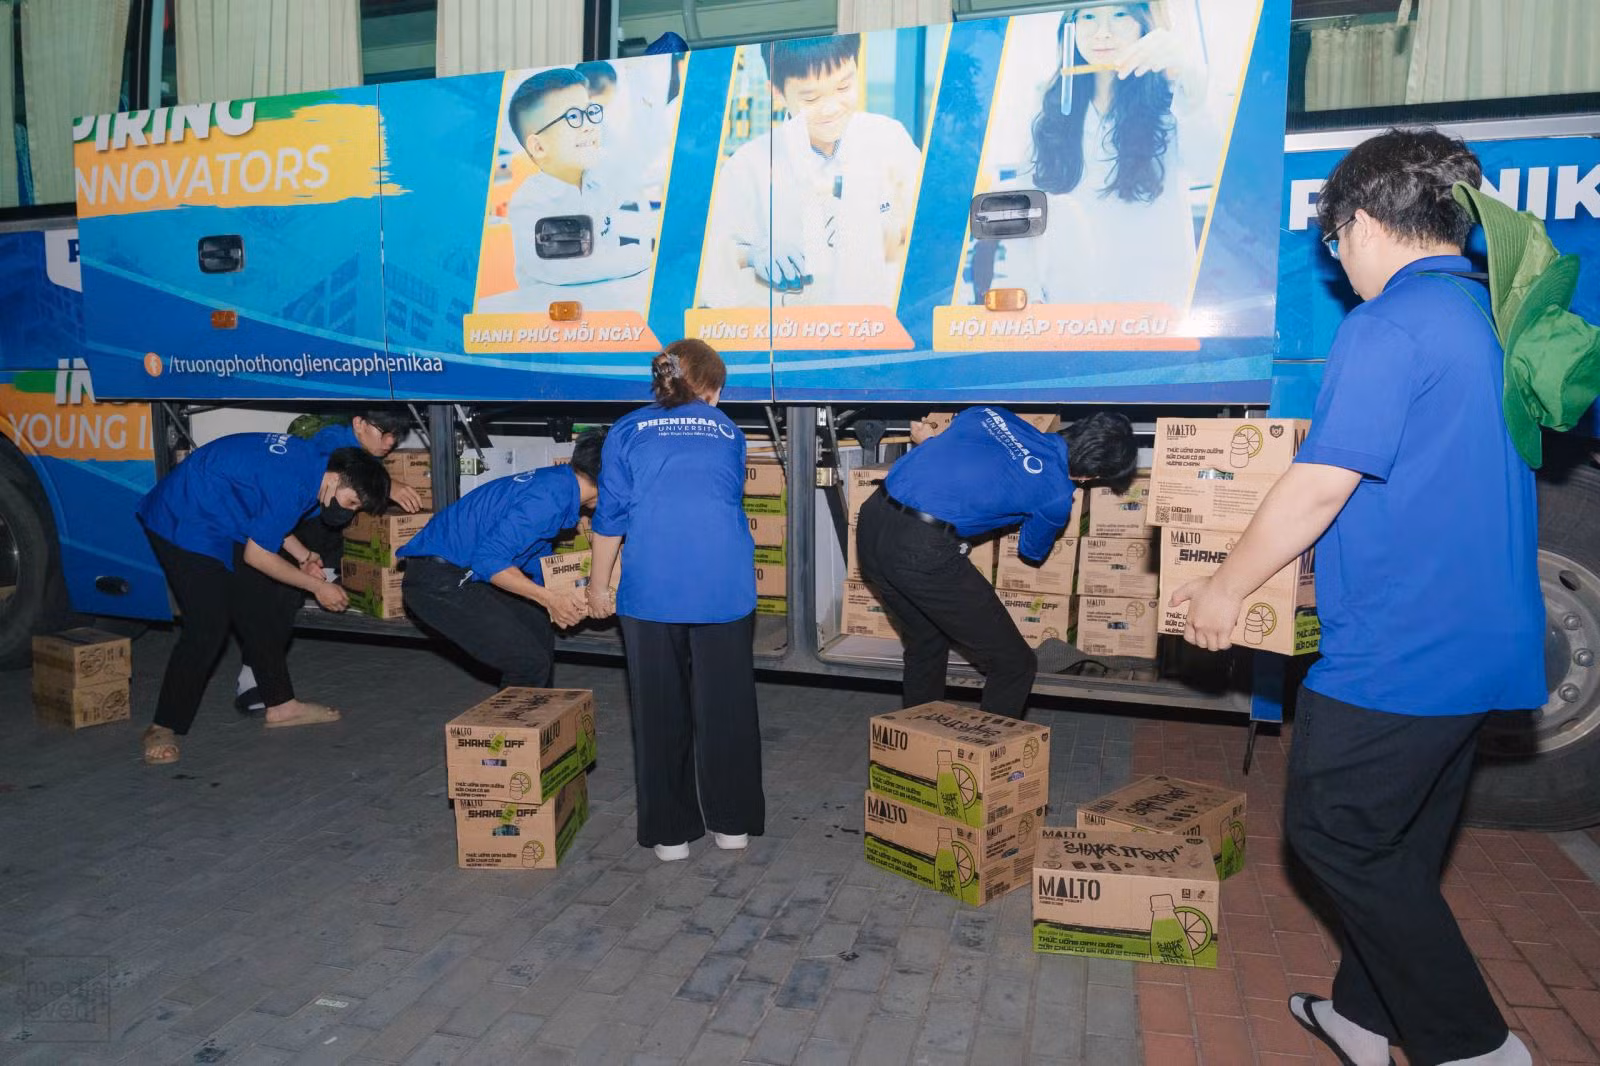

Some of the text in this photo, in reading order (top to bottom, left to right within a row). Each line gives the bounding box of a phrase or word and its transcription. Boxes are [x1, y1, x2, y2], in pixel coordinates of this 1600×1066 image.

[9, 413, 128, 449] YOUNG
[1166, 424, 1197, 436] MALTO
[1170, 530, 1200, 544] MALTO
[1179, 549, 1227, 564] SHAKE
[553, 563, 580, 575] SHAKE
[458, 739, 525, 748] SHAKE OFF
[872, 724, 908, 751] MALTO
[468, 809, 537, 819] SHAKE OFF
[867, 796, 907, 824] MALTO
[1042, 830, 1086, 839] MALTO
[1038, 875, 1101, 901] MALTO
